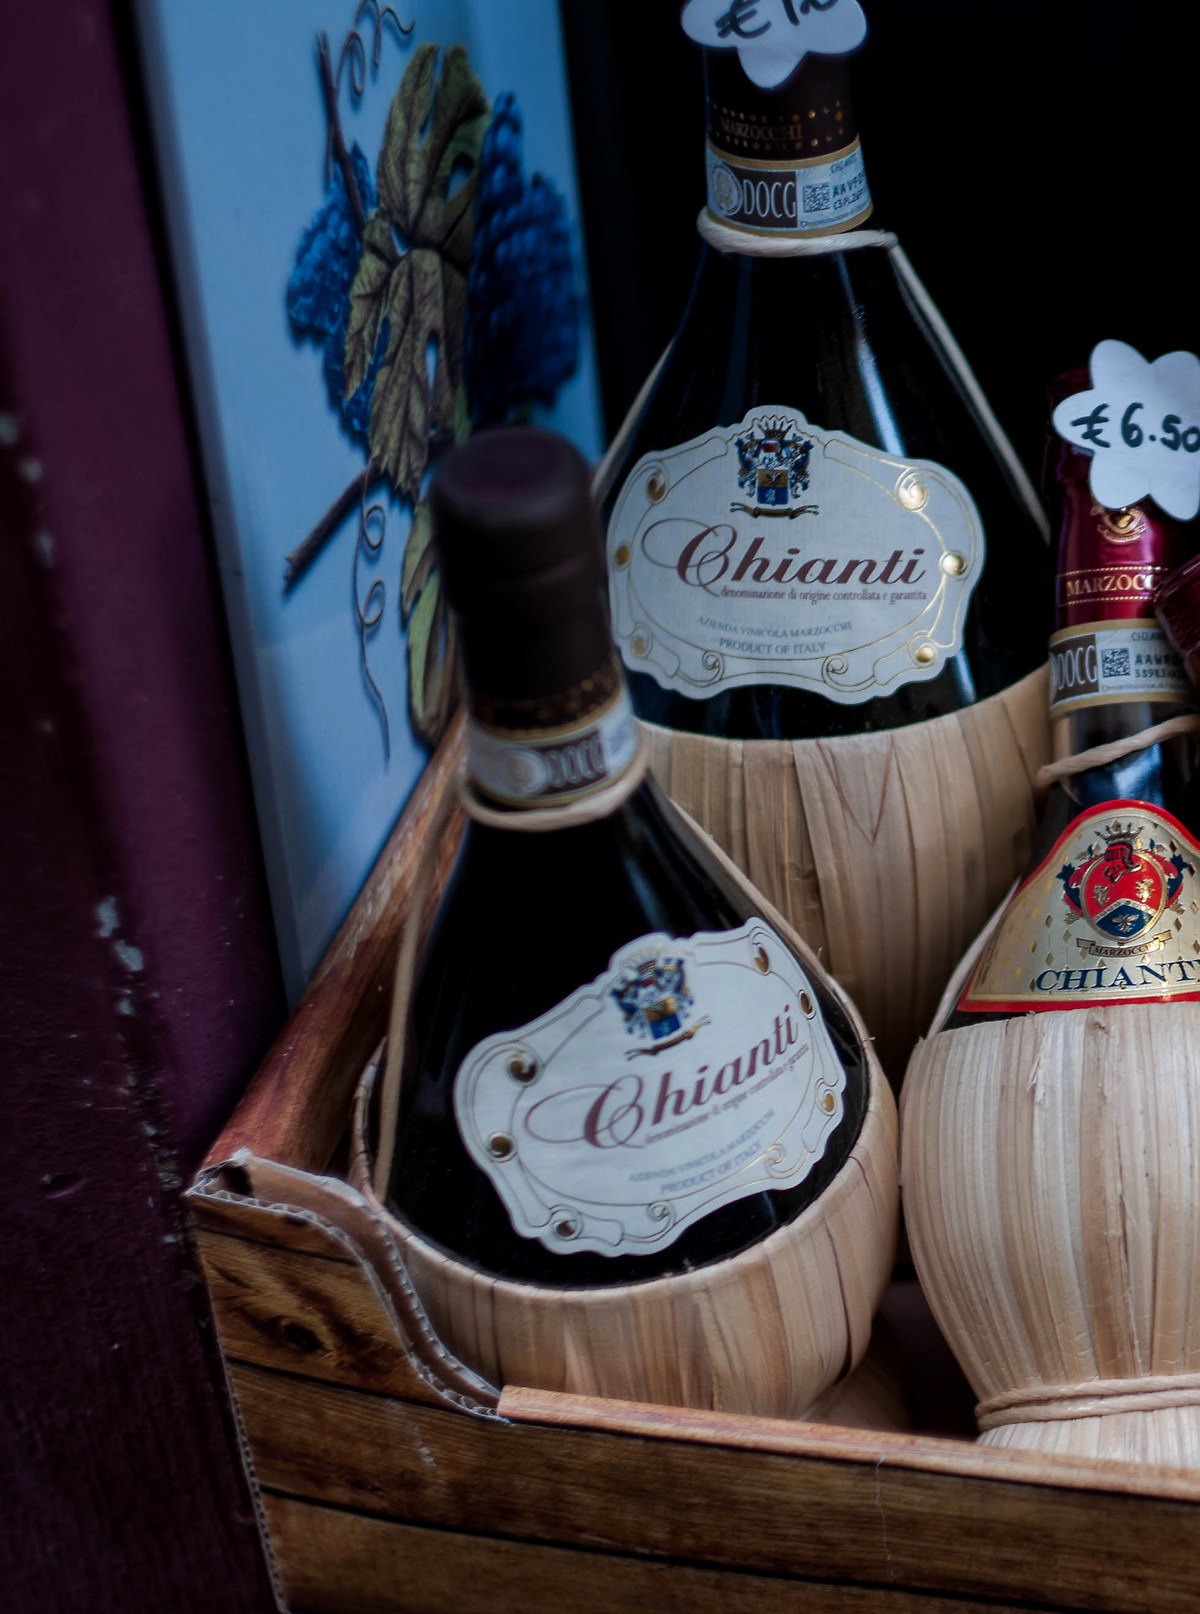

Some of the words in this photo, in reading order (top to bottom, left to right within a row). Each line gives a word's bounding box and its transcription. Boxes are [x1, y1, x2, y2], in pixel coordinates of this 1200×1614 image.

[743, 179, 797, 218] DOCG
[641, 517, 926, 599] Chianti
[720, 586, 786, 599] denominazione
[788, 586, 797, 600] di
[799, 589, 831, 605] origine
[833, 588, 880, 601] controllata
[890, 590, 927, 605] garantita
[1066, 573, 1157, 596] MARZOCC
[697, 616, 738, 635] AZIENDA
[741, 626, 788, 639] VINICOLA
[790, 620, 853, 638] MARZOCCHI
[719, 637, 773, 655] PRODUCT
[774, 642, 790, 655] OF
[793, 640, 827, 655] ITALY
[524, 1004, 800, 1150] Chianti
